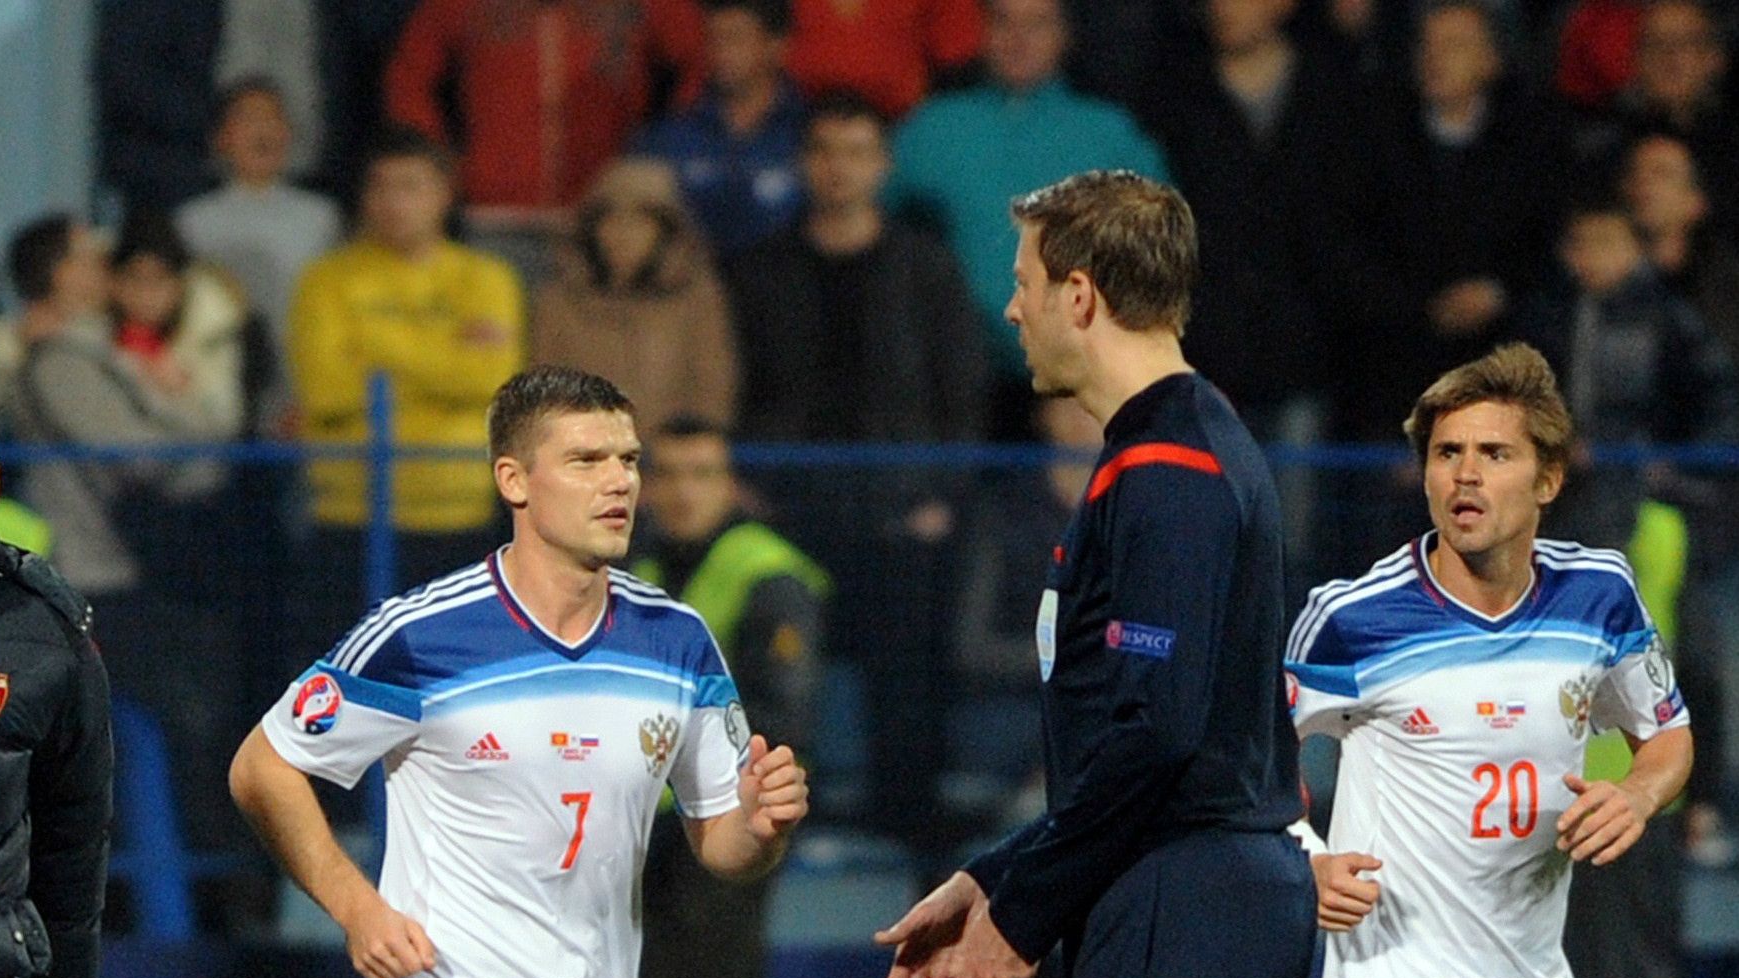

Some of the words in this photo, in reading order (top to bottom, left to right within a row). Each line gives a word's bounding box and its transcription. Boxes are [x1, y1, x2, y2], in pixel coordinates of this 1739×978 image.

[465, 750, 510, 761] adidas
[561, 792, 593, 870] 7
[1470, 760, 1538, 839] 20
